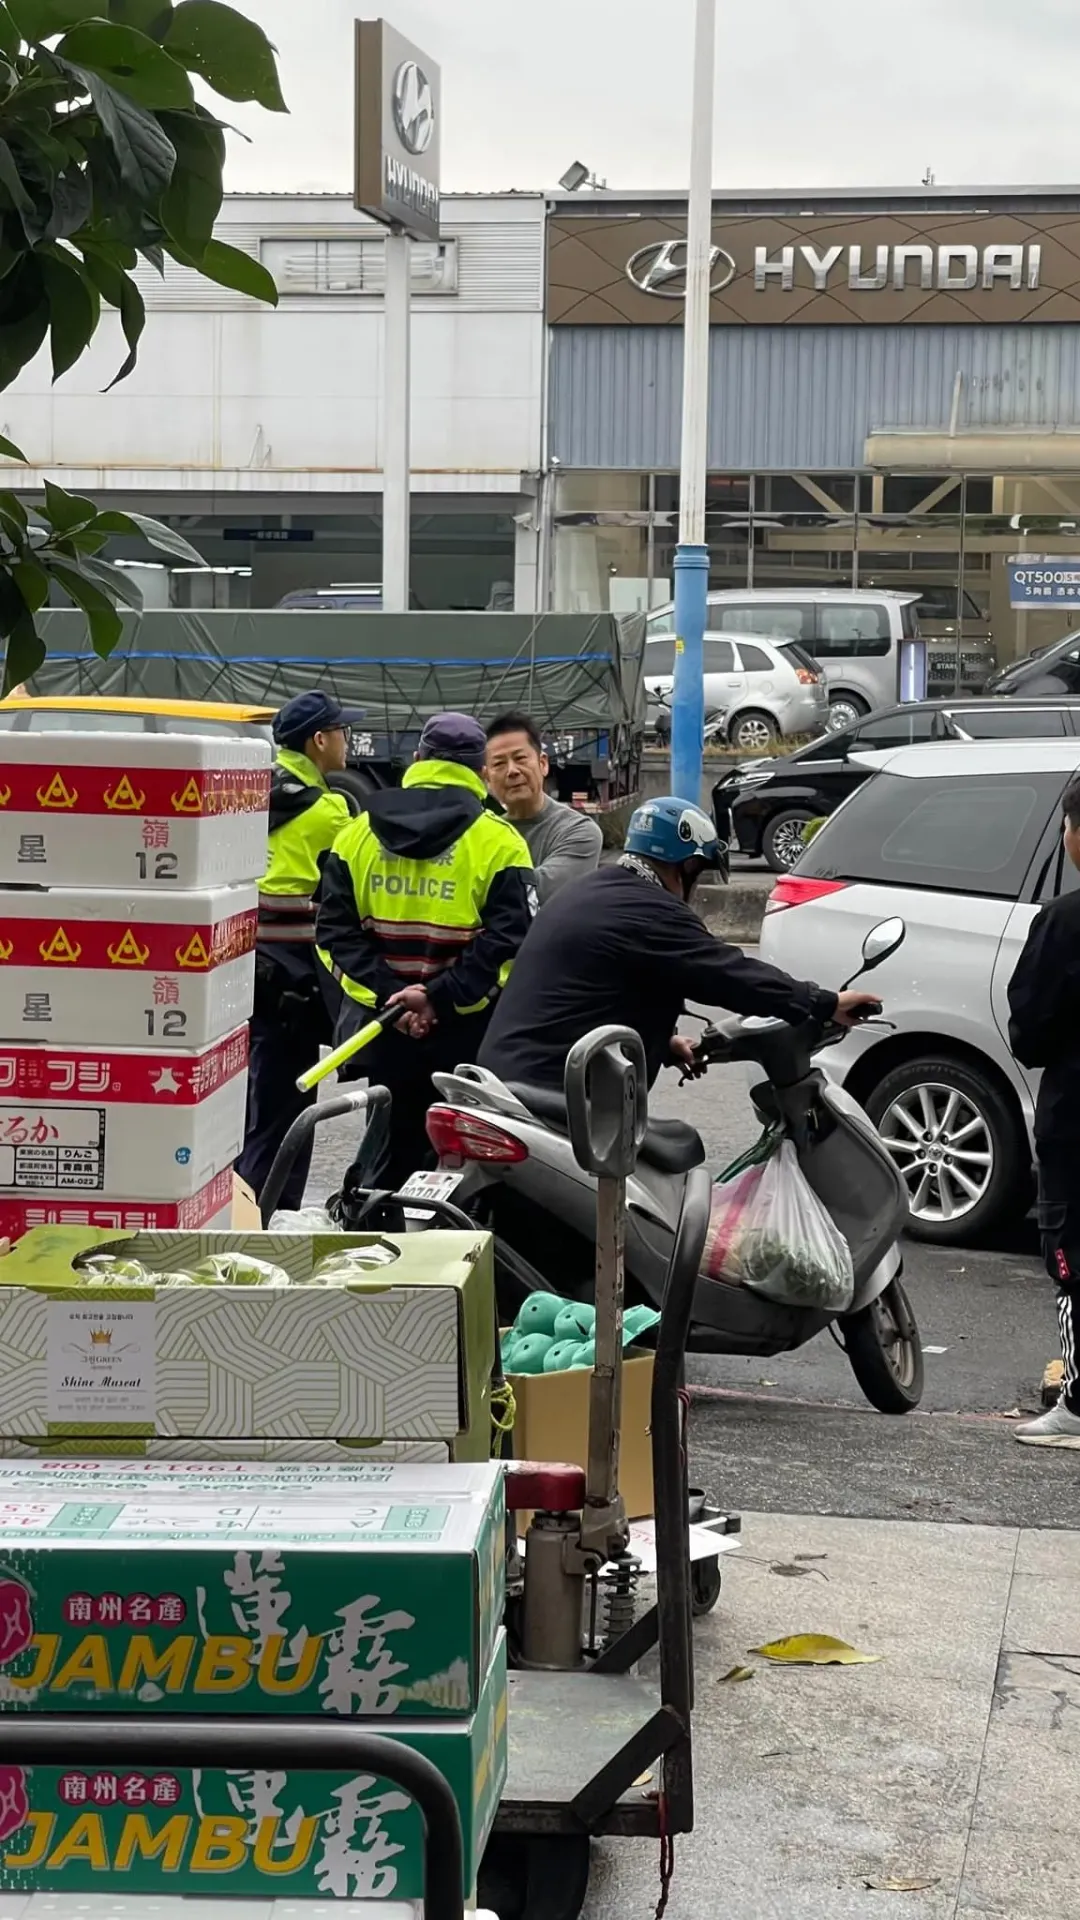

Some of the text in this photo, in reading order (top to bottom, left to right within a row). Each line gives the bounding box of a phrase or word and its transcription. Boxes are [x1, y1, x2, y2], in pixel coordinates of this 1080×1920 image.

[385, 154, 439, 222] HYUNDAI
[754, 244, 1041, 292] HYUNDAI
[1014, 570, 1063, 586] QT500
[142, 818, 169, 848] 嶺
[18, 834, 47, 863] 星
[135, 852, 178, 880] 12
[371, 873, 457, 901] POLICE
[152, 975, 180, 1005] 嶺
[22, 993, 52, 1022] 星
[144, 1009, 187, 1037] 12
[0, 1115, 59, 1144] るか
[61, 1375, 141, 1388] Shine Muscat
[68, 1597, 182, 1621] 南州名產
[11, 1634, 326, 1694] JAMBU
[63, 1777, 178, 1801] 南州名產
[5, 1811, 322, 1874] JAMBU
